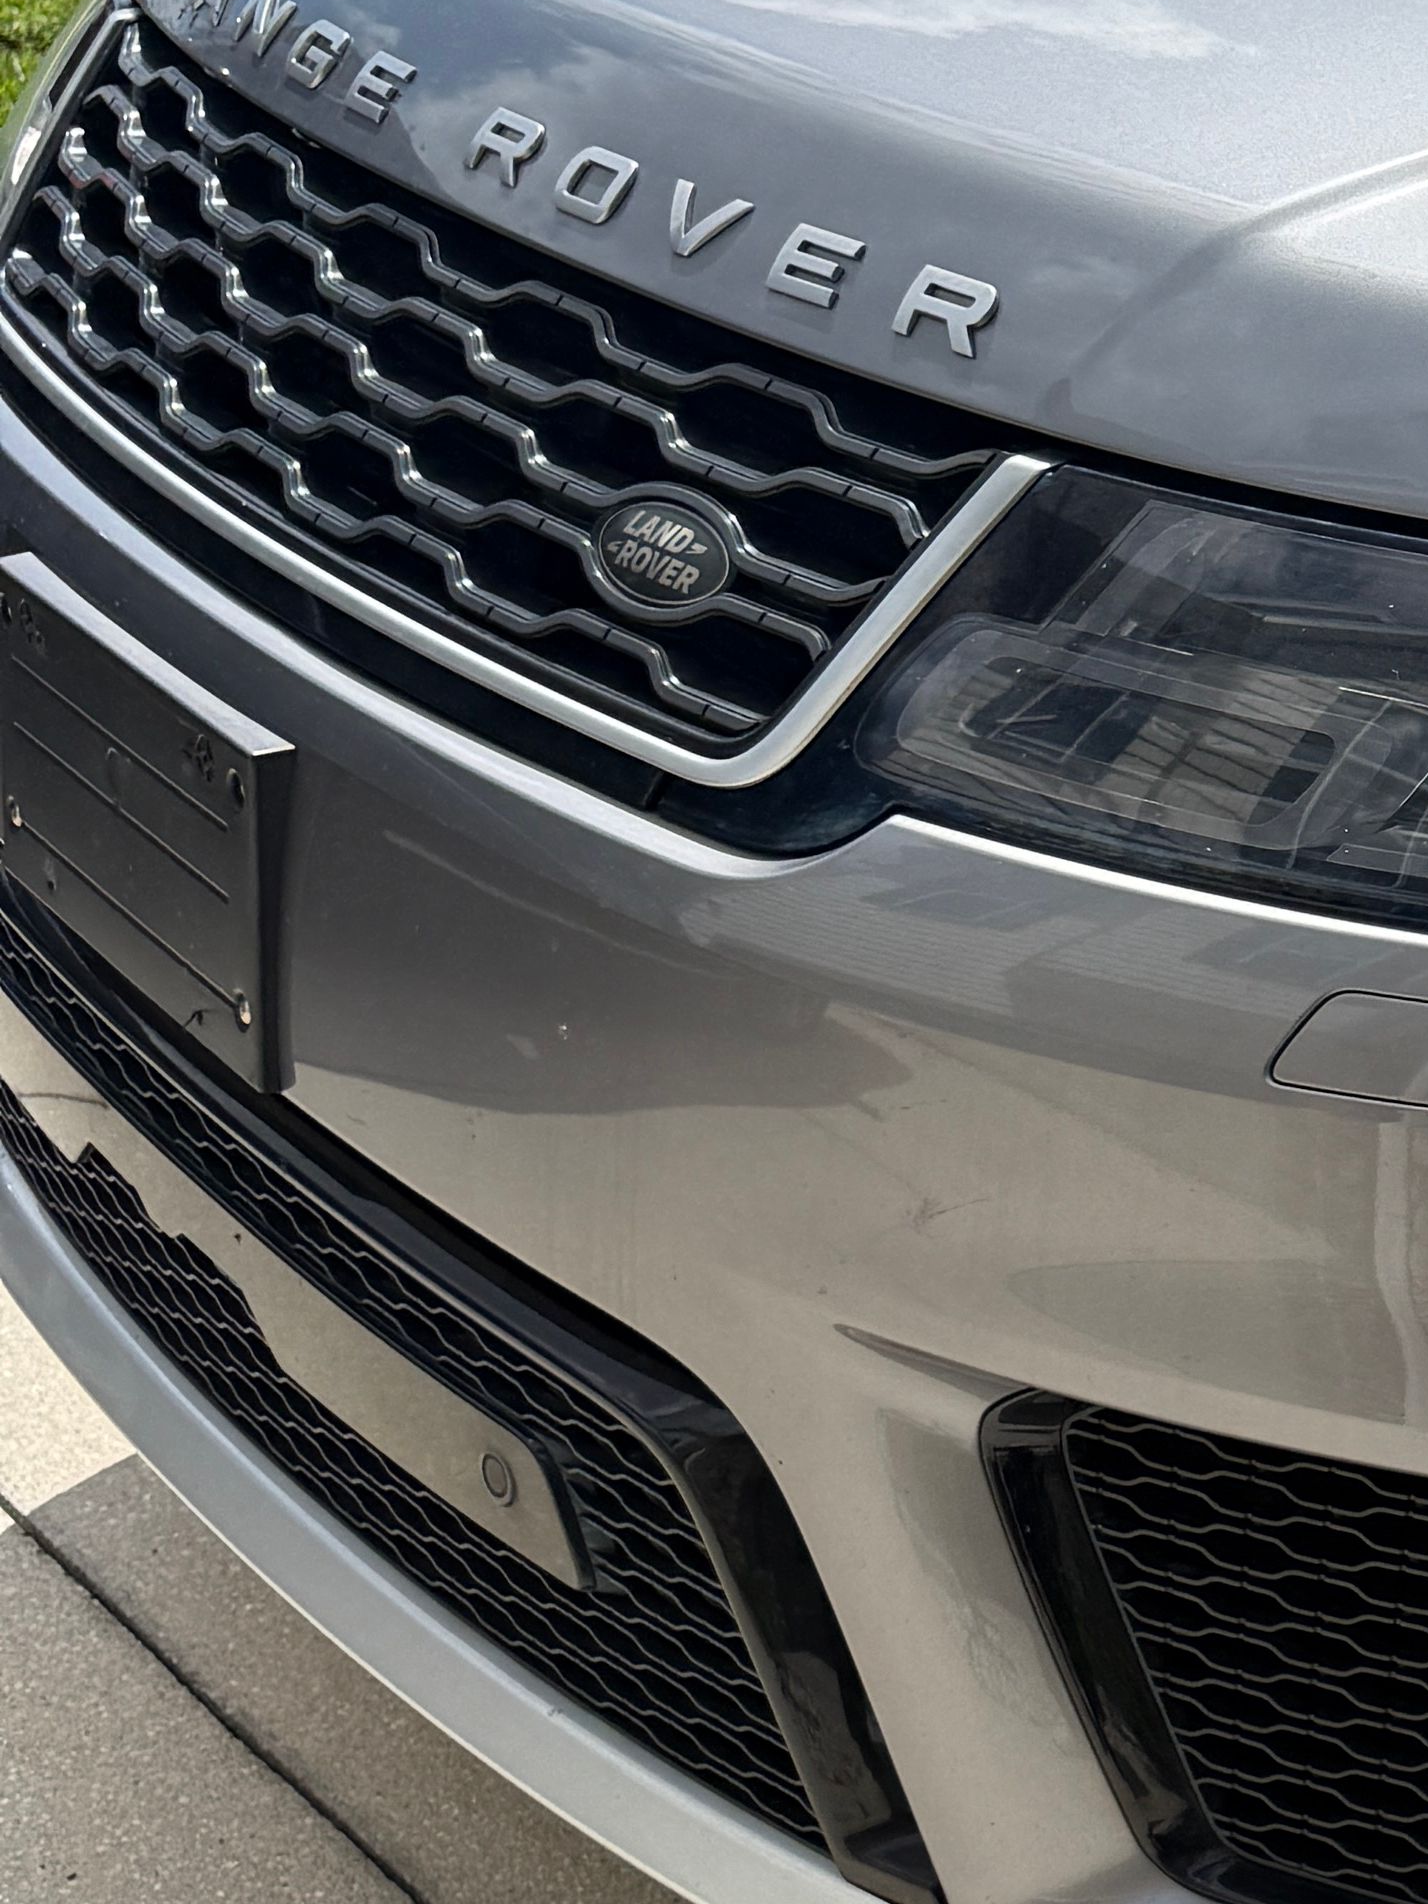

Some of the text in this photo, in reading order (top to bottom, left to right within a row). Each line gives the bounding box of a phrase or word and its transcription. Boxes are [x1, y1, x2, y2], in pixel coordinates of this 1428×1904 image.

[463, 105, 1000, 359] ROVER
[623, 510, 695, 553] LAND
[614, 539, 700, 594] ROVER
